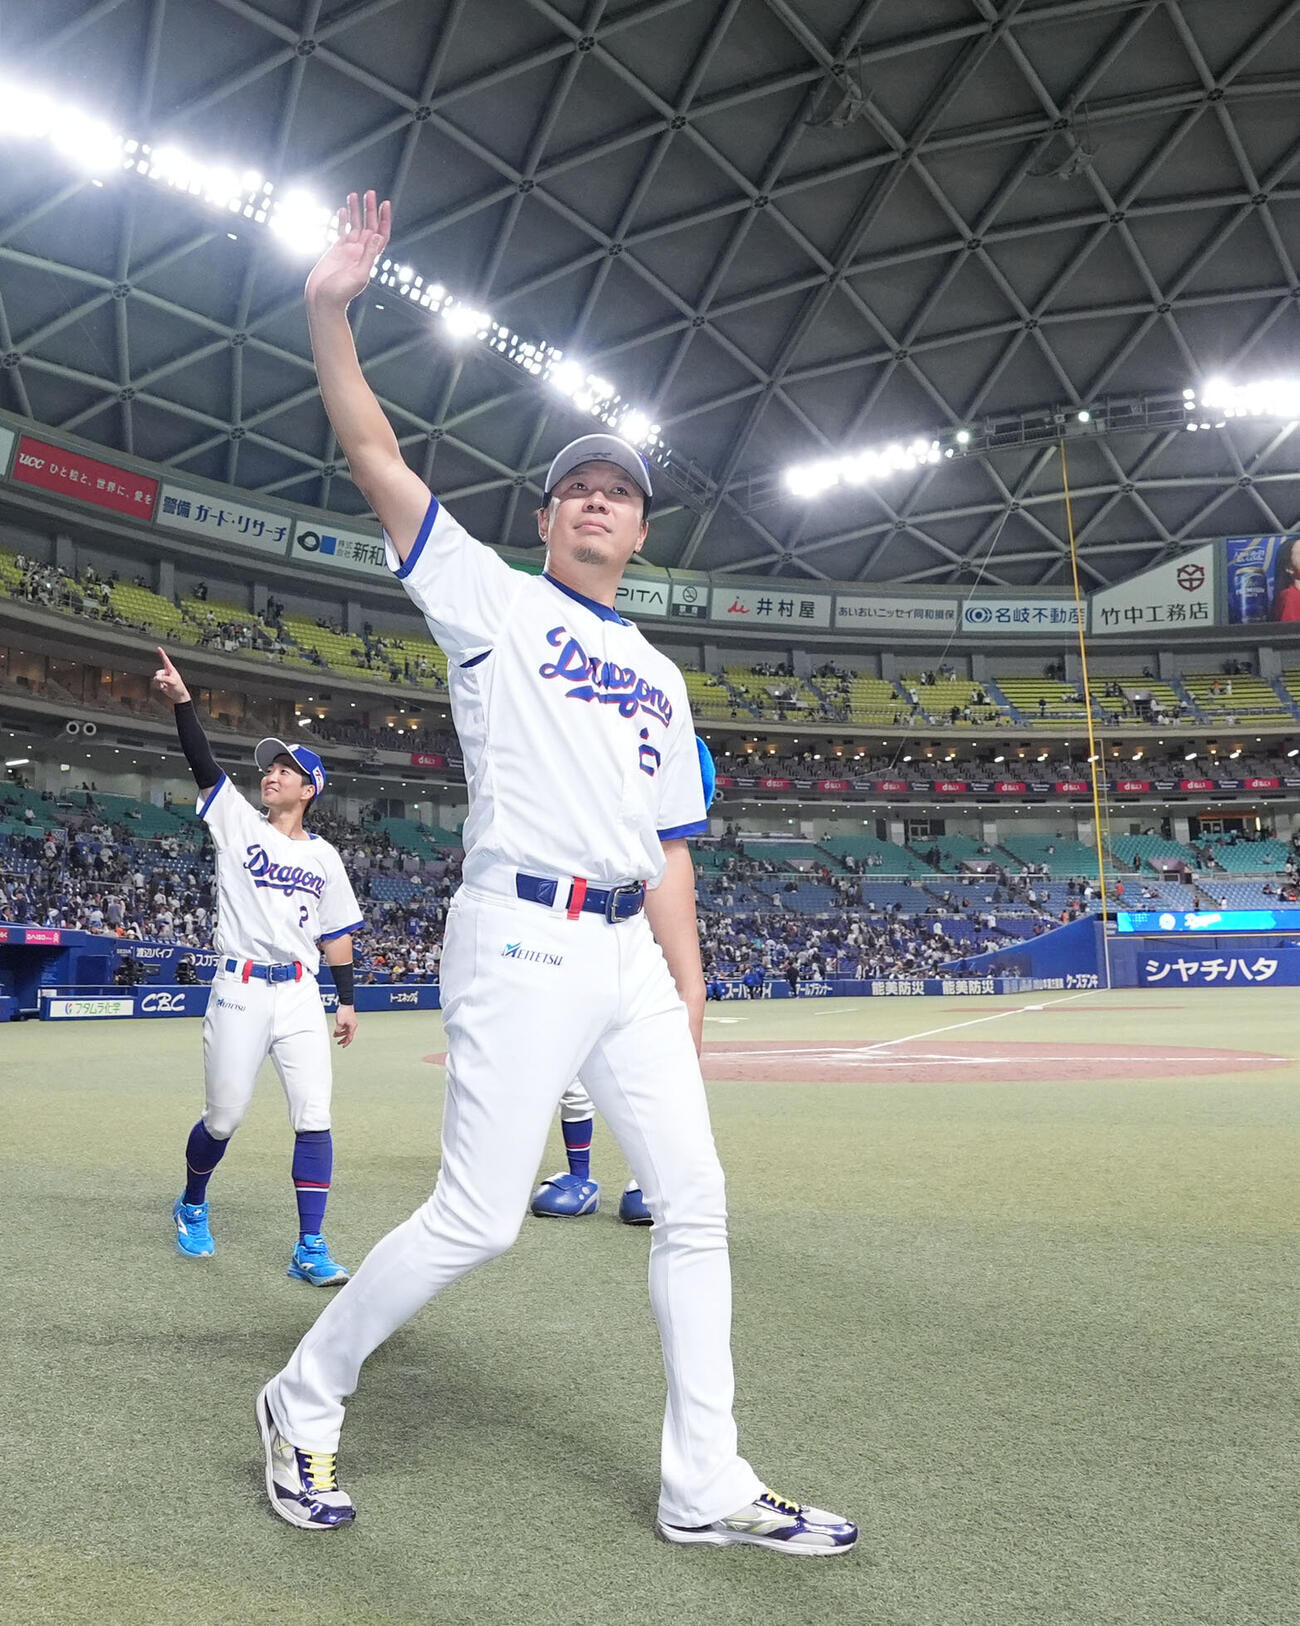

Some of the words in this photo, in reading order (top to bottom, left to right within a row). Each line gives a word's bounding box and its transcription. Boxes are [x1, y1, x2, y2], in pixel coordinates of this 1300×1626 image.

[163, 496, 191, 518] 警備
[195, 505, 287, 542] ガード・リサーチ
[756, 597, 816, 619] 井村屋
[838, 607, 954, 620] あいおいニッセイ同和損保
[995, 607, 1085, 624] 名岐不動産
[1100, 602, 1209, 626] 竹中工務店
[1145, 957, 1279, 982] シヤチハタ
[872, 981, 925, 996] 能美防災
[942, 980, 995, 995] 能美防災
[141, 992, 186, 1012] CBC
